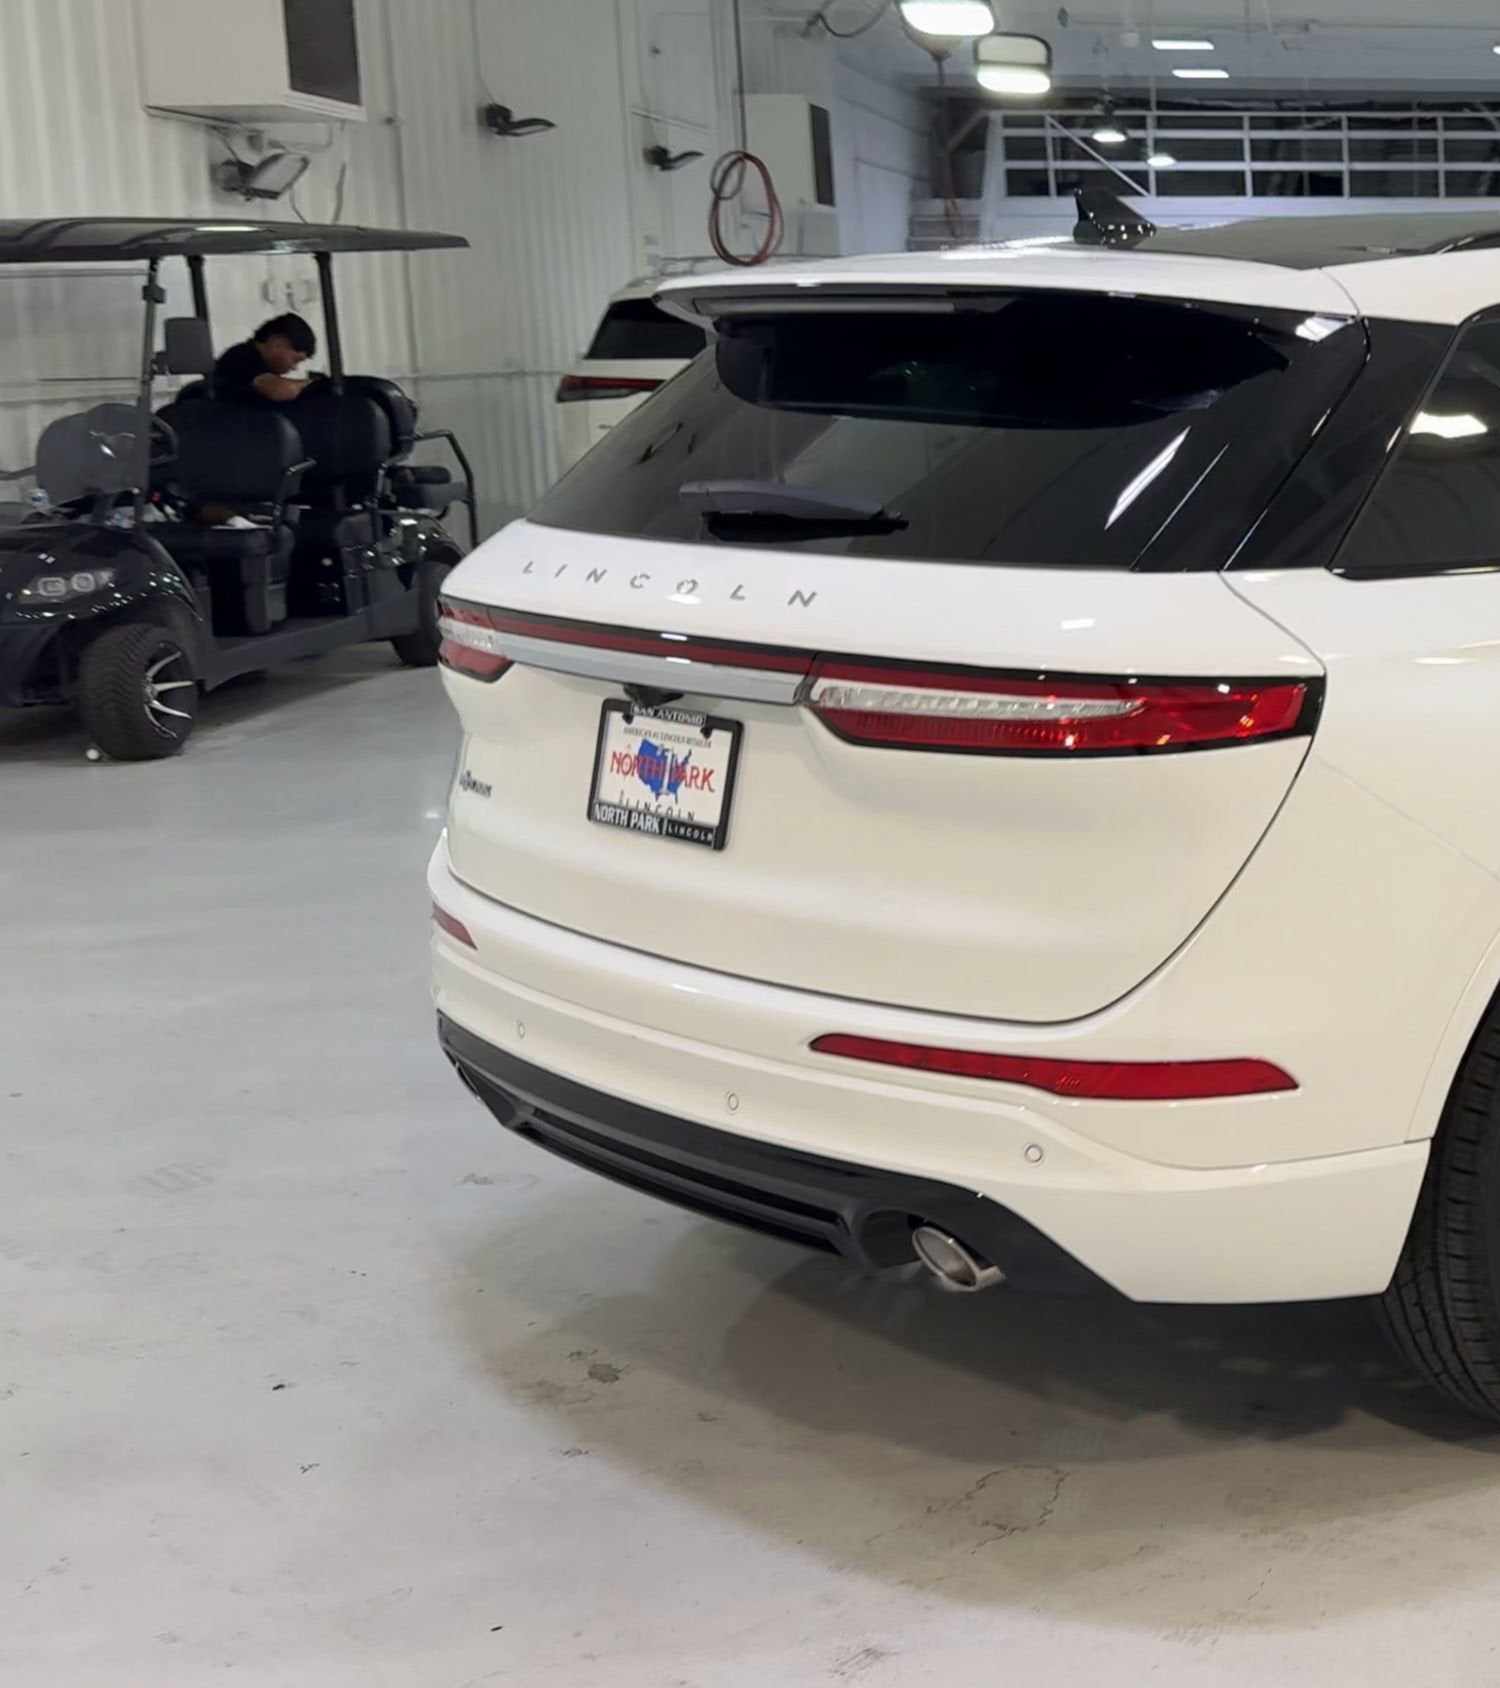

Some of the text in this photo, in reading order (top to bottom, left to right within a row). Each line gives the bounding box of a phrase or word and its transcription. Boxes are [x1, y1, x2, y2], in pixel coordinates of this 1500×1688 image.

[522, 561, 817, 608] LINCOLN
[632, 705, 704, 726] SAN ANTONIO
[610, 751, 715, 793] NORTH PARK
[593, 803, 713, 841] NORTH PARK LINCOLN
